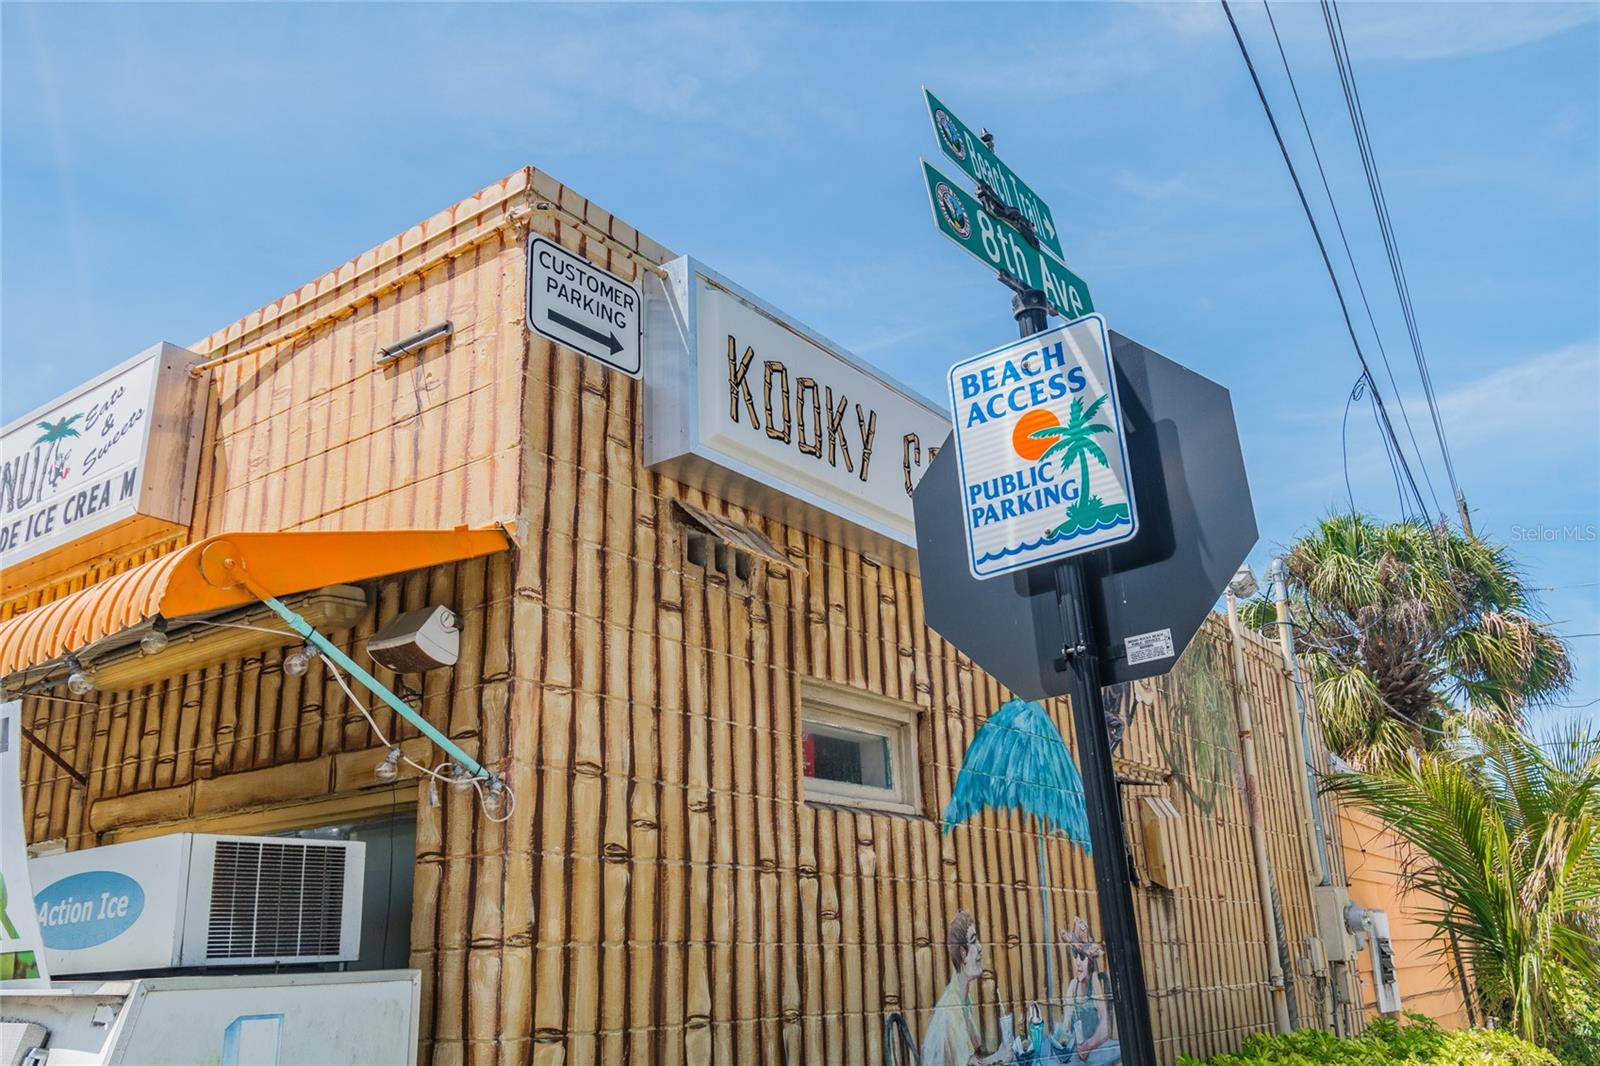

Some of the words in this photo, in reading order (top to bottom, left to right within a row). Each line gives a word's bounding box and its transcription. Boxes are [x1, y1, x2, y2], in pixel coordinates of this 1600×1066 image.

[964, 131, 1013, 207] Beach
[1008, 174, 1047, 240] Trail
[976, 209, 1032, 288] 8th
[538, 250, 634, 313] CUSTOMER
[546, 276, 627, 329] PARKING
[960, 341, 1066, 400] BEACH
[966, 366, 1087, 428] ACCESS
[85, 386, 126, 431] Eats
[101, 413, 114, 437] &
[728, 334, 877, 482] KOOKY
[83, 408, 144, 476] Sweets
[969, 462, 1055, 505] PUBLIC
[972, 479, 1080, 529] PARKING
[25, 504, 57, 542] ICE
[39, 897, 93, 927] Action
[97, 892, 129, 920] Ice
